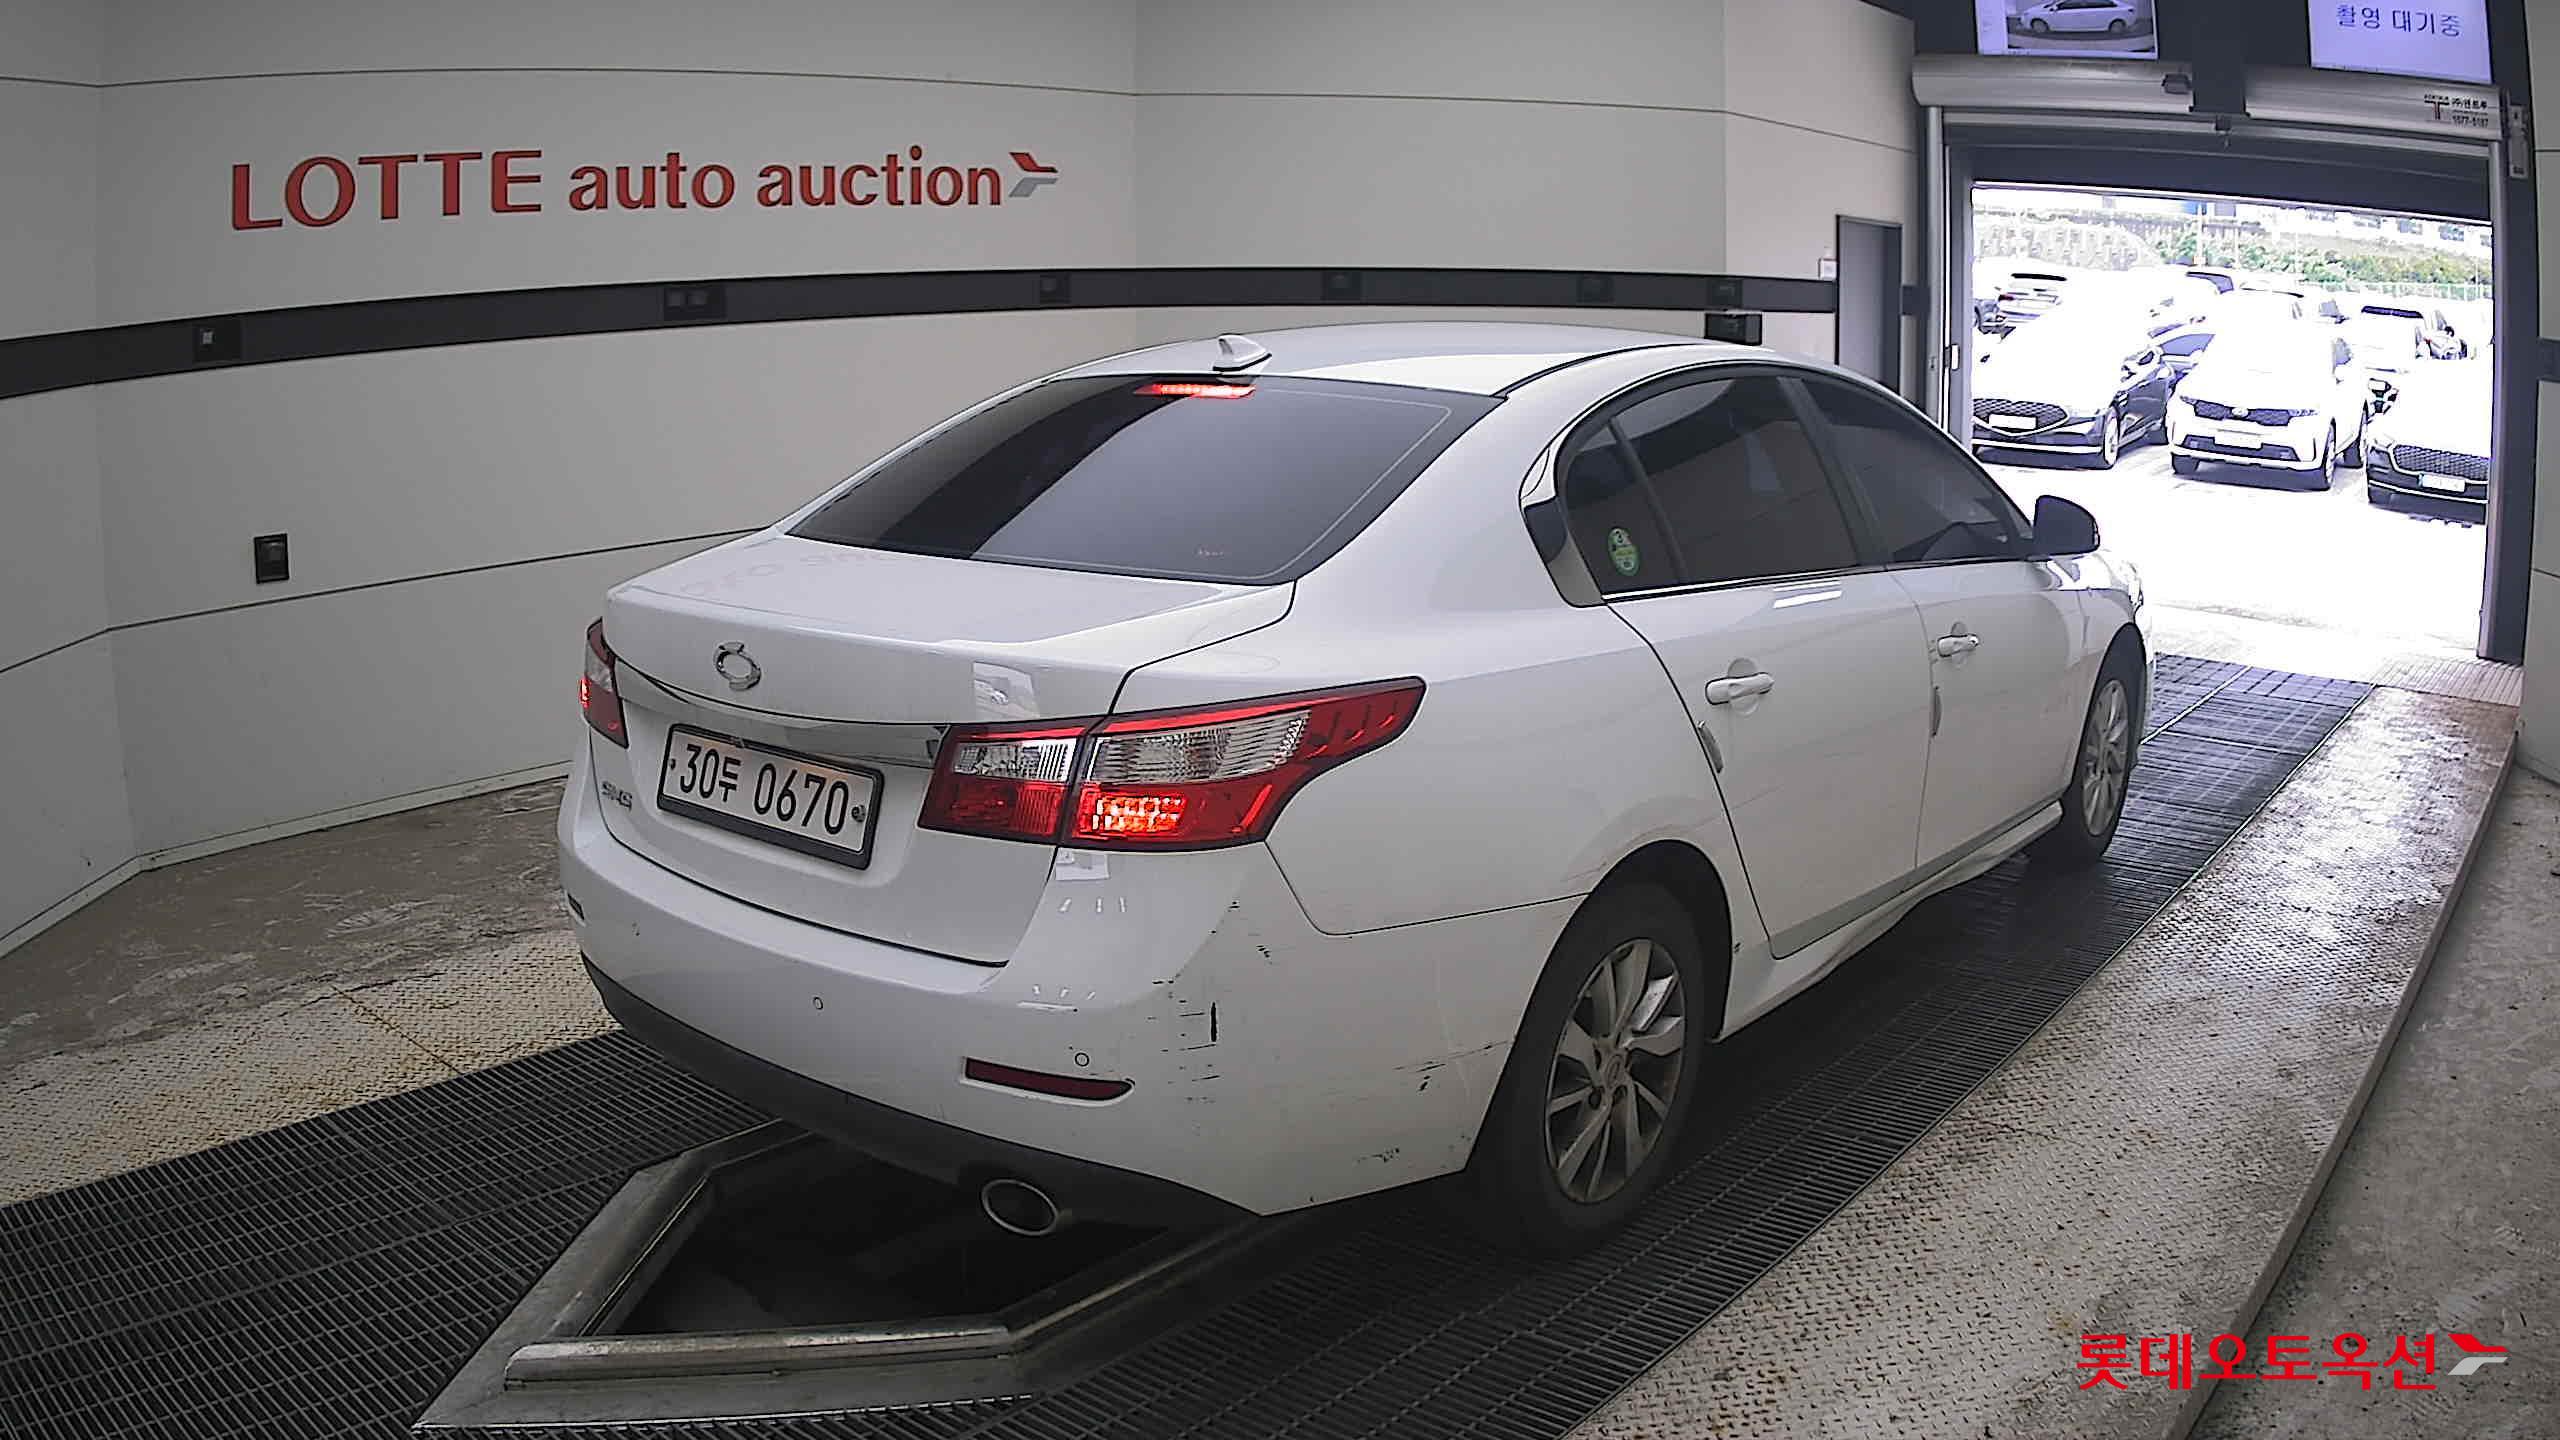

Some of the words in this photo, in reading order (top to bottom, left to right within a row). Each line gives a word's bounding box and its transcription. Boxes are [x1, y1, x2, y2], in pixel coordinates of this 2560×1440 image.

[2337, 4, 2381, 30] 촬영
[2392, 9, 2460, 37] 대기중
[232, 149, 542, 231] LOTTE
[568, 151, 735, 210] auto
[756, 145, 1001, 207] auction
[679, 743, 741, 803] 30두
[754, 762, 850, 836] 0670
